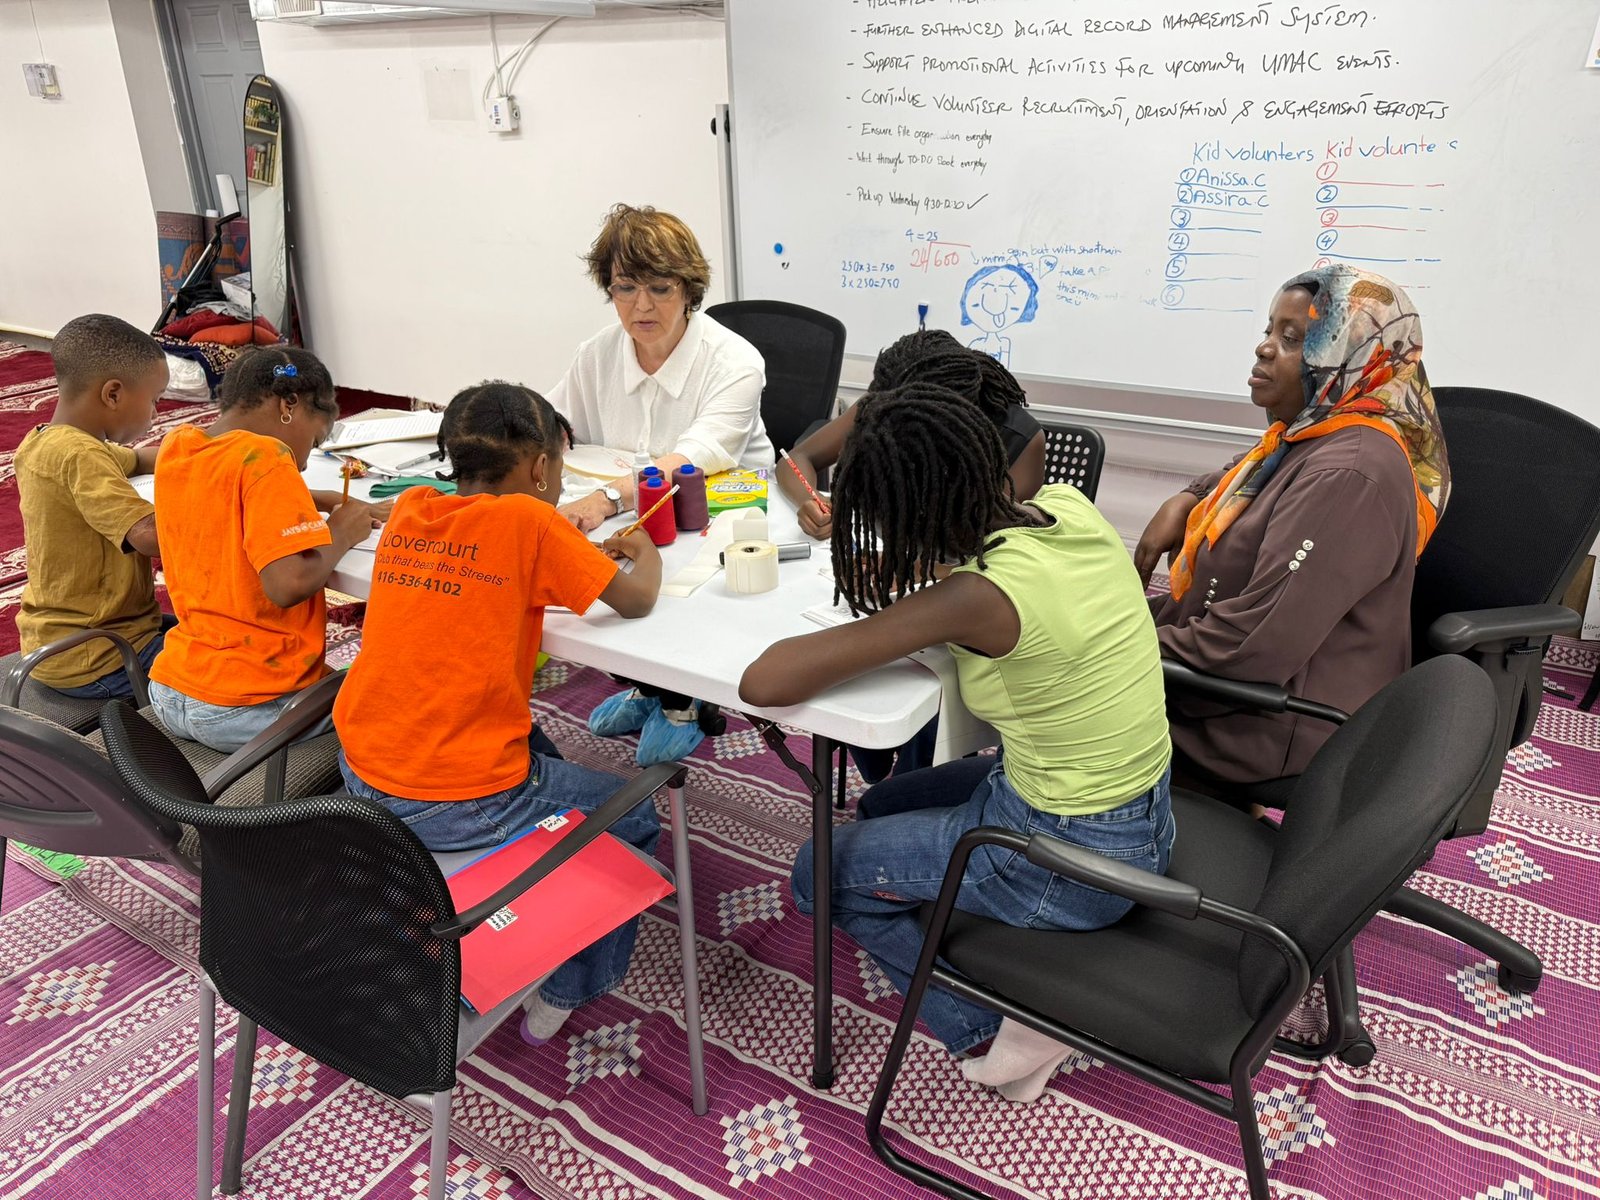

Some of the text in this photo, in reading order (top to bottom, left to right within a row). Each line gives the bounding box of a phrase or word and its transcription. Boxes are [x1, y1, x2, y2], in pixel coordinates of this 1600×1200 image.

[863, 23, 915, 38] FURTHER
[921, 22, 1004, 38] ENHANCED
[1014, 20, 1073, 38] DIGITAL
[1084, 19, 1151, 34] RECORD
[1162, 2, 1272, 29] MANAGEMENT
[922, 57, 1019, 75] PROMOTIONAL
[1028, 57, 1106, 76] ACTIVITIES
[1115, 57, 1154, 78] FOR
[1262, 50, 1322, 76] UMAC
[861, 87, 927, 108] CONTINUE
[933, 94, 1013, 114] VOLUNTEER
[1135, 98, 1228, 120] ORIENTATION
[1263, 93, 1374, 119] ENGAGEMENT
[861, 122, 893, 136] Ensure
[897, 124, 911, 137] file
[965, 129, 992, 149] everyday
[1326, 136, 1354, 160] Kid
[876, 151, 904, 174] through
[960, 156, 987, 176] everyday
[1192, 140, 1314, 165] Kid volunters
[926, 231, 938, 241] 25
[391, 554, 411, 567] that
[436, 562, 456, 574] the
